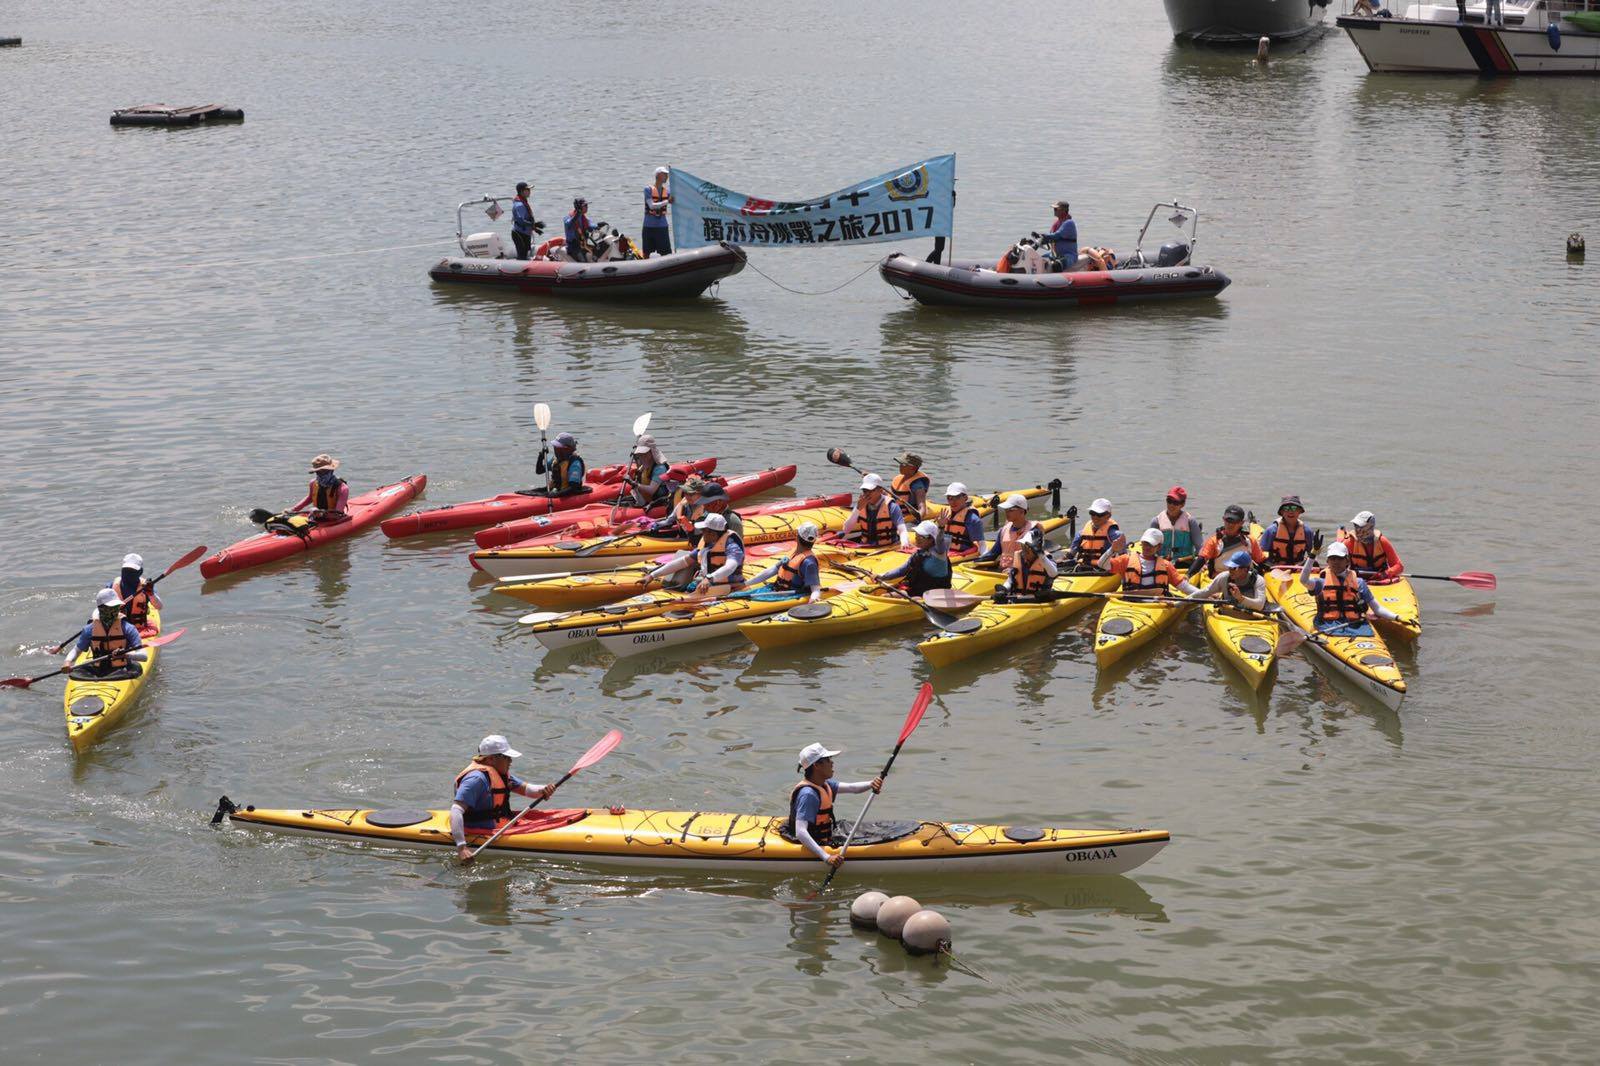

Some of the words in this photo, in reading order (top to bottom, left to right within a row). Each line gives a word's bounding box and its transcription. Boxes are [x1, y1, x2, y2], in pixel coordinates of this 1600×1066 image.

[702, 206, 935, 244] 獨木舟挑戰之旅2017
[750, 534, 768, 543] LAND
